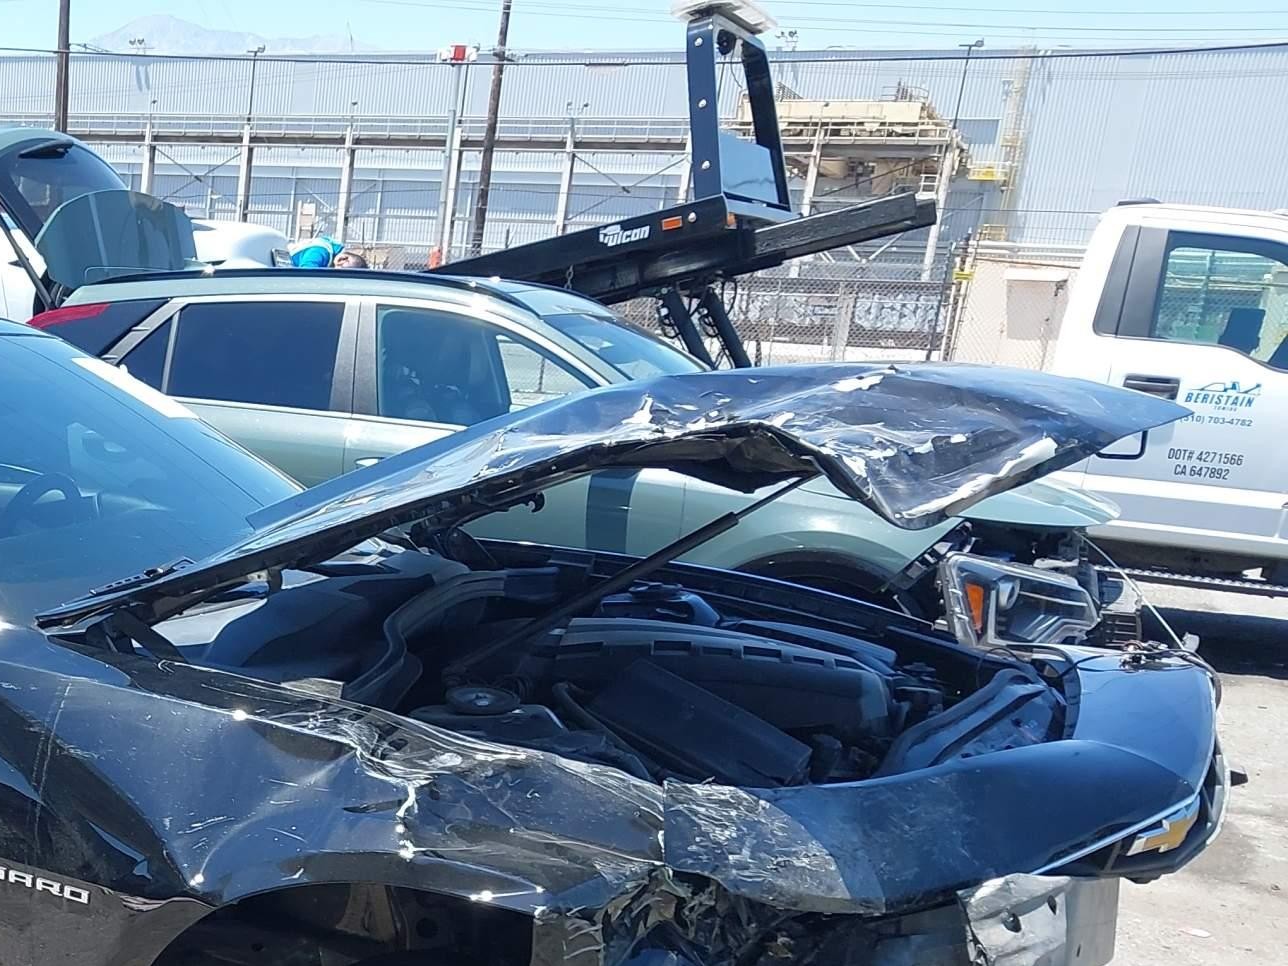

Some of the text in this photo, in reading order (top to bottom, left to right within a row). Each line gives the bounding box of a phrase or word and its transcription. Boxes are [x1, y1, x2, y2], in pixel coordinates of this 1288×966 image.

[1184, 392, 1255, 408] BERISTAIN
[1167, 447, 1244, 466] DOT# 4271566
[1174, 463, 1230, 481] CA 647892
